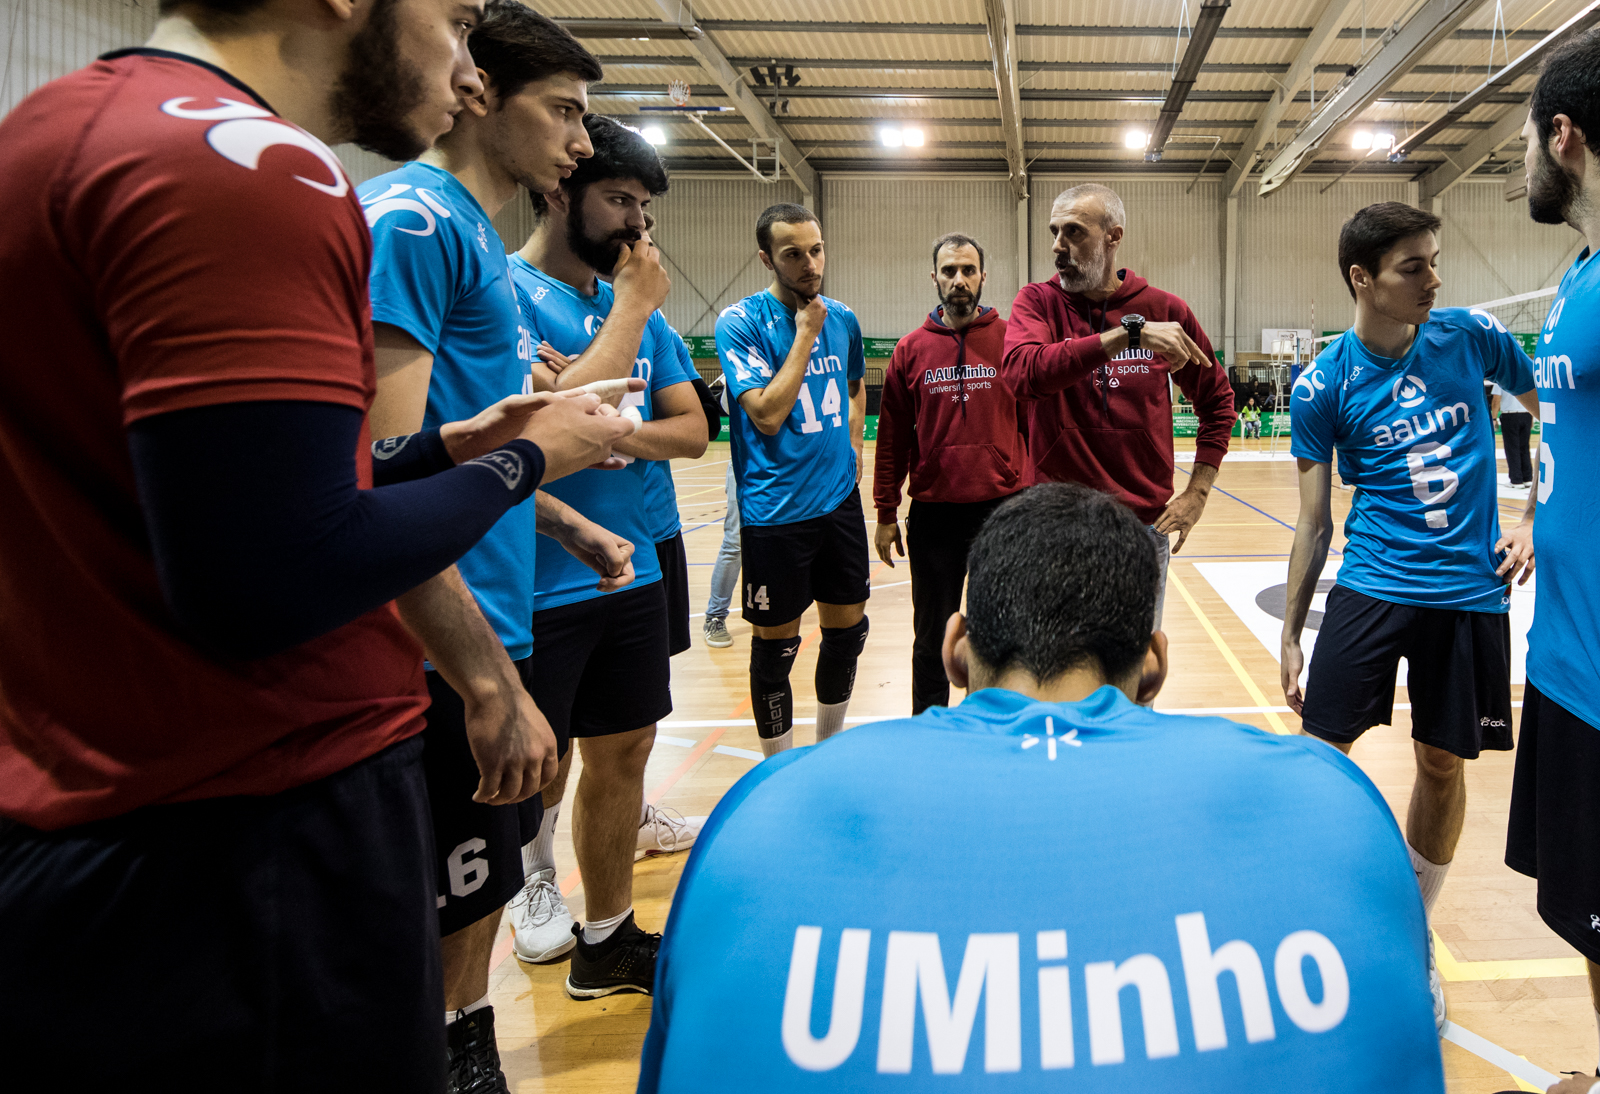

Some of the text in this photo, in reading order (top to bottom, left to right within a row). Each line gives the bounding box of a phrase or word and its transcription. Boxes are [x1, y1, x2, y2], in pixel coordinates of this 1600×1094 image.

[726, 346, 773, 382] 14
[924, 363, 997, 384] AAUMinho
[1117, 364, 1150, 376] sports
[1533, 354, 1575, 389] aum
[966, 380, 992, 391] sports
[798, 378, 842, 434] 14
[1372, 402, 1470, 446] aaum
[1406, 440, 1459, 505] 6
[747, 583, 769, 610] 14
[781, 911, 1350, 1075] UMinho
